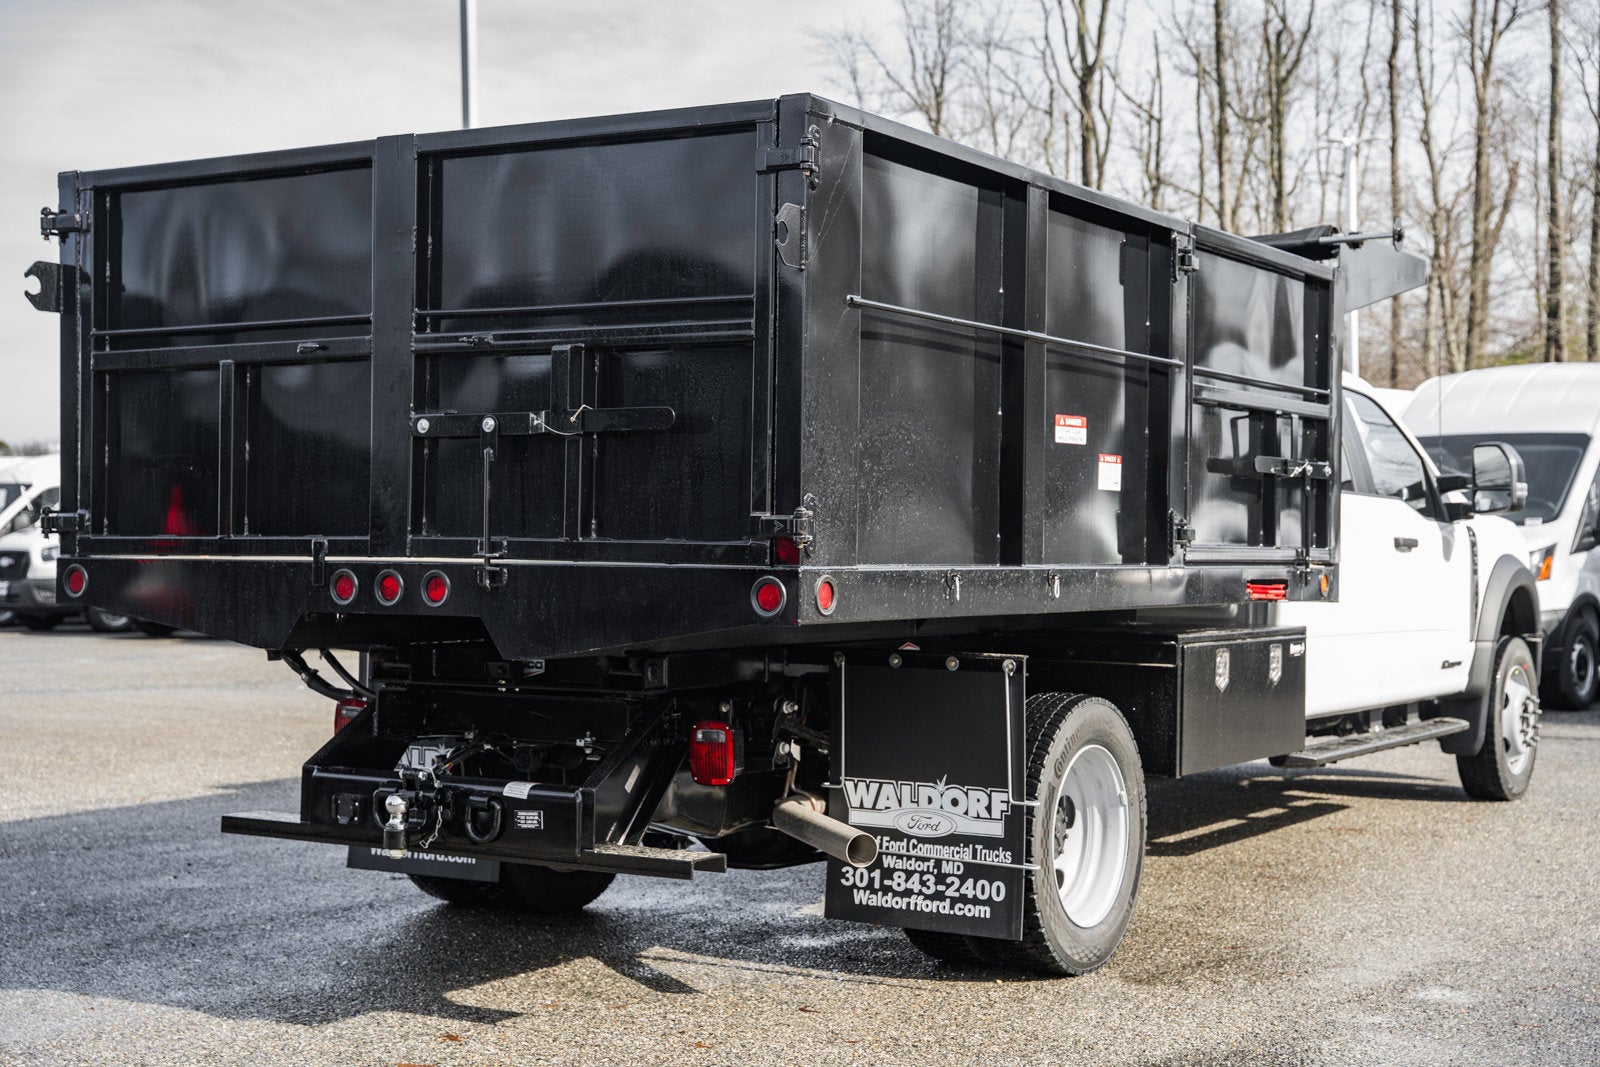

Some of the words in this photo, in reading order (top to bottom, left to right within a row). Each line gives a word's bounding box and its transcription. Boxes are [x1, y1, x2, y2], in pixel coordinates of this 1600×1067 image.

[843, 779, 1009, 820] WALDORF
[907, 814, 942, 832] Ford
[882, 836, 908, 852] Ford
[909, 838, 973, 861] Commercial
[975, 845, 1012, 863] Trucks
[882, 854, 938, 875] Waldorf,
[941, 861, 965, 875] MD
[840, 866, 1006, 902] 301-843-2400
[853, 888, 991, 919] Waldorfford.com
